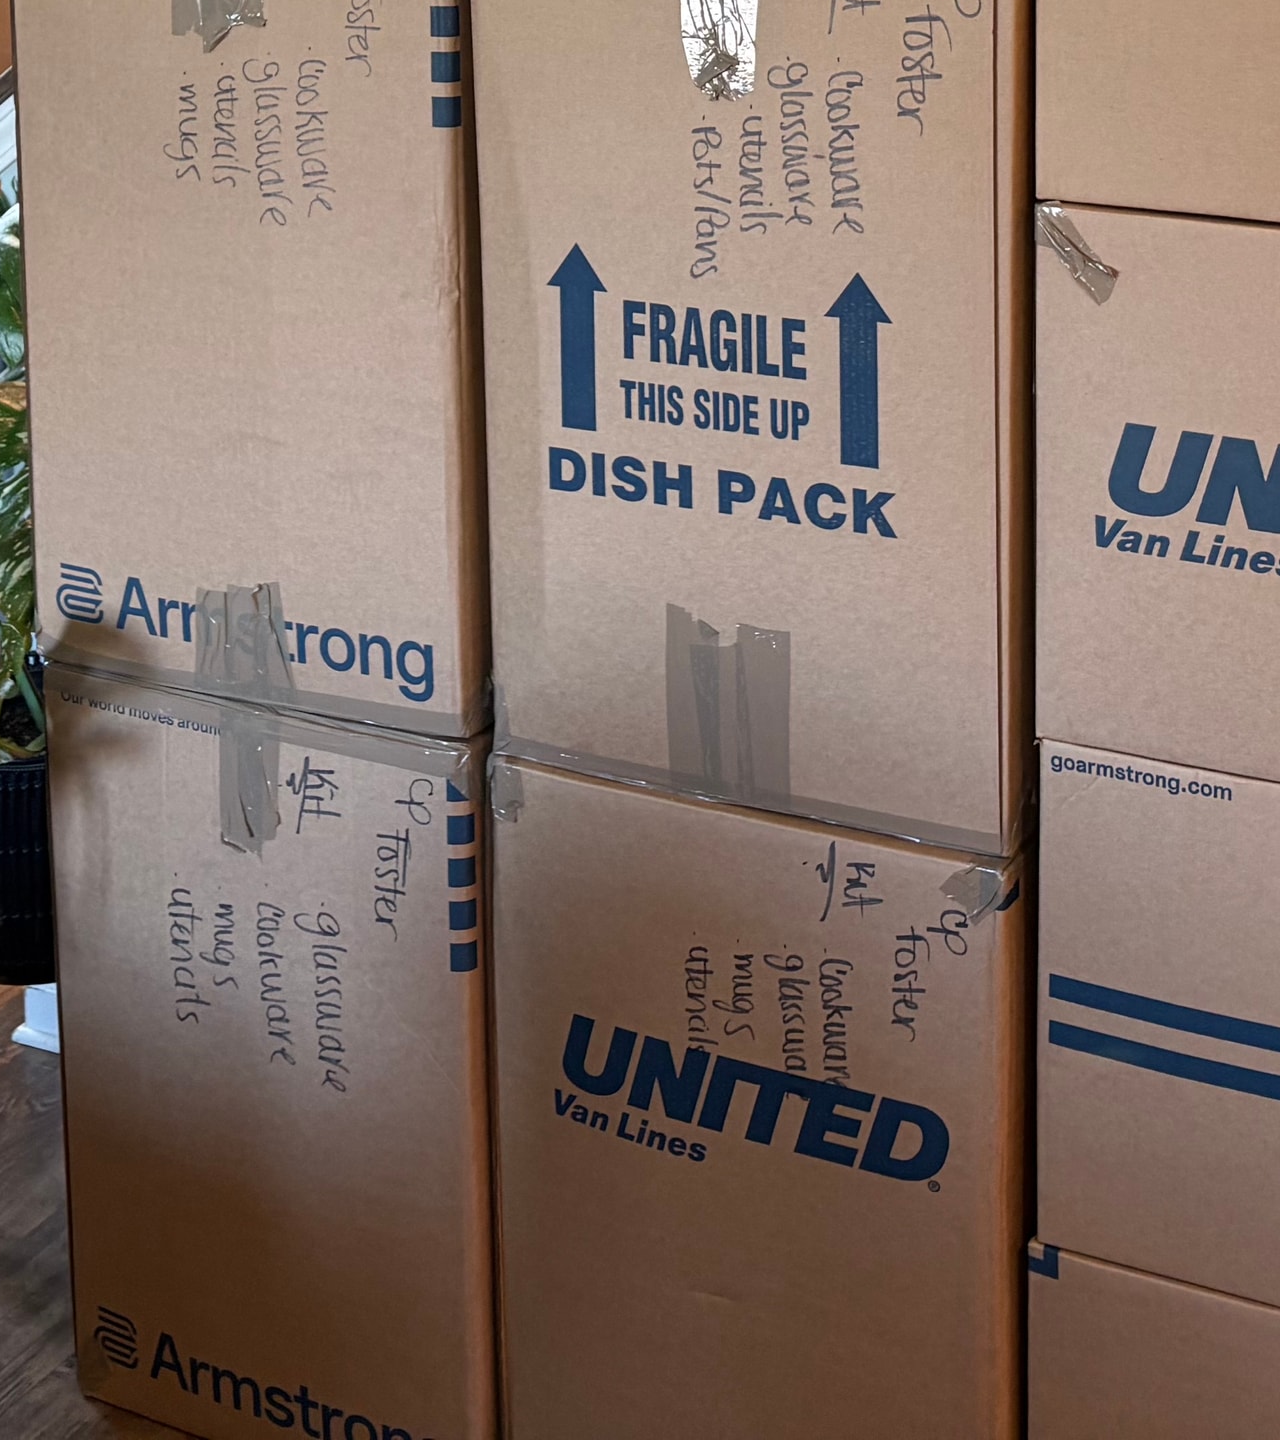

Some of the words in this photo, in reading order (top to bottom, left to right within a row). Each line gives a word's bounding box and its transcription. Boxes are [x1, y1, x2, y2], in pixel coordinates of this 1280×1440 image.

[163, 81, 201, 182] mugs
[622, 299, 807, 381] FRAGILE
[619, 378, 684, 426] THIS
[693, 387, 760, 436] SIDE
[770, 397, 810, 441] UP
[548, 446, 693, 510] DISH
[717, 468, 898, 540] PACK
[1093, 514, 1170, 560] Van
[128, 706, 175, 726] moves
[177, 717, 221, 736] aroun
[1050, 752, 1233, 803] goarmstrong.com
[199, 902, 238, 991] mugs
[711, 953, 755, 1041] mugs
[552, 1088, 609, 1132] Van
[616, 1110, 708, 1163] Lines
[561, 1013, 950, 1181] UNITED
[149, 1331, 436, 1440] Armstro
